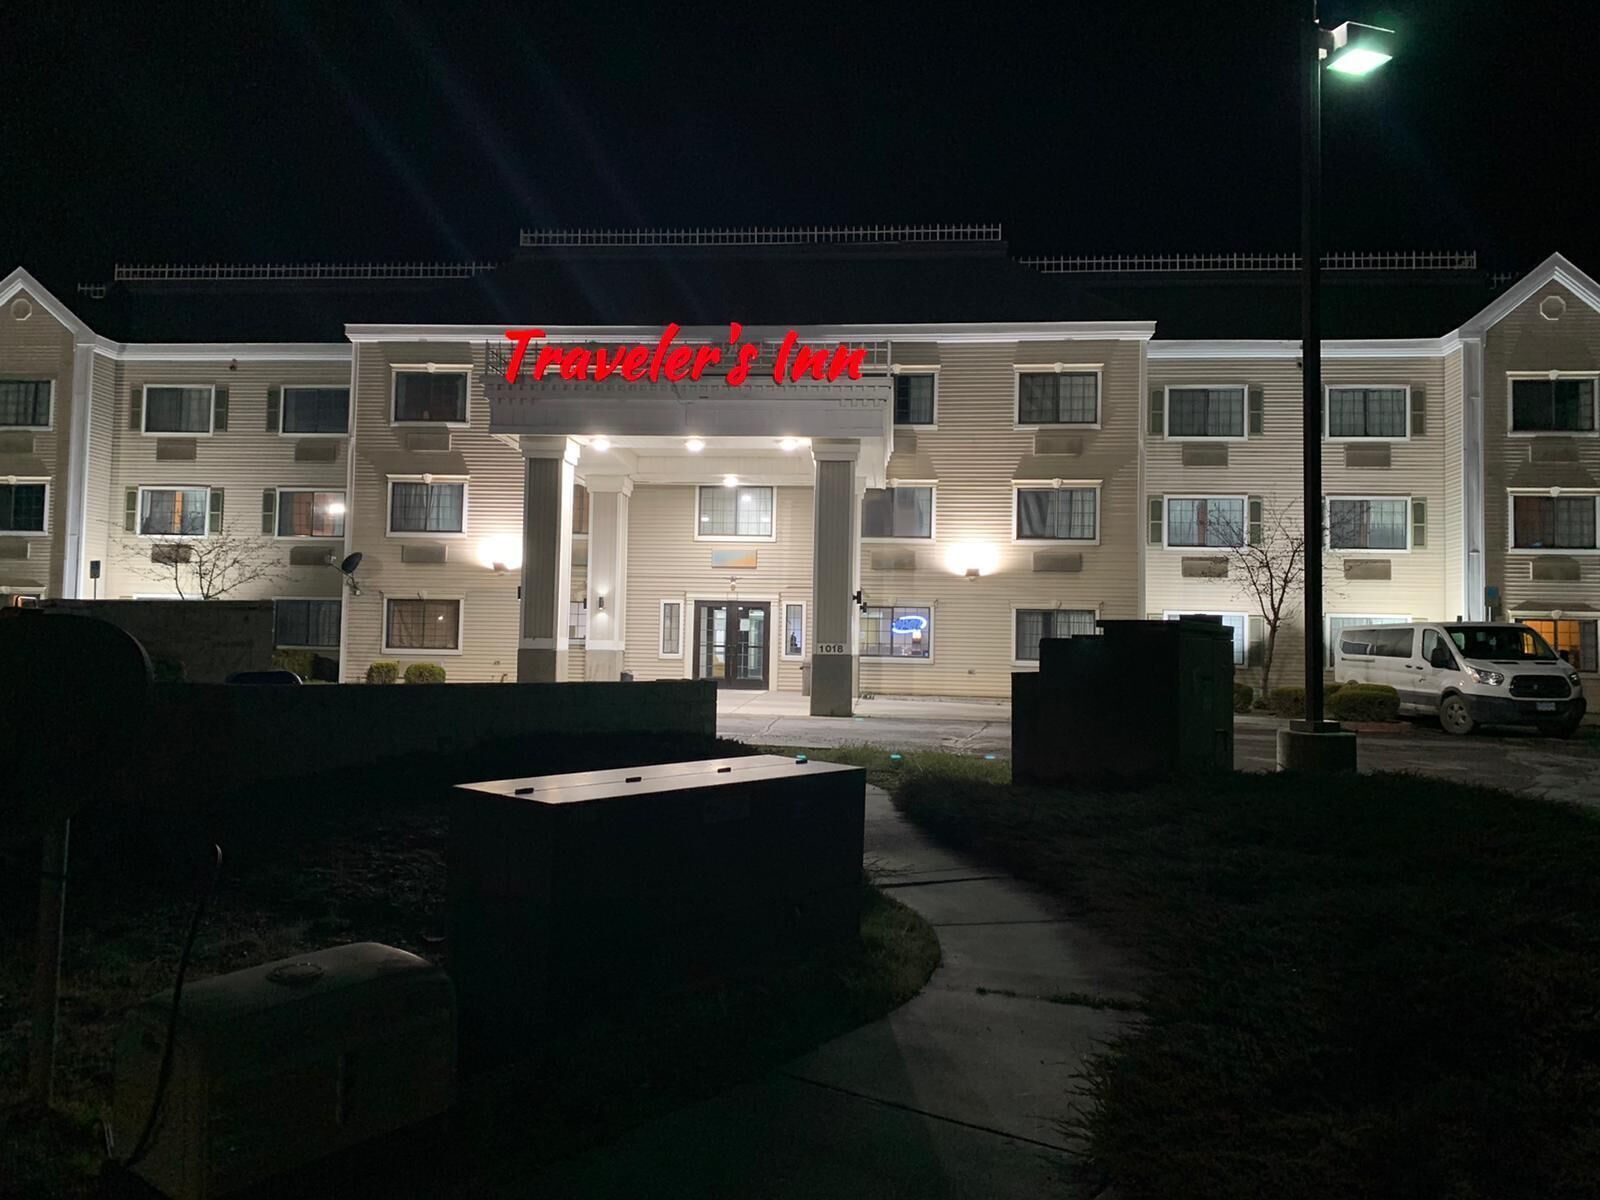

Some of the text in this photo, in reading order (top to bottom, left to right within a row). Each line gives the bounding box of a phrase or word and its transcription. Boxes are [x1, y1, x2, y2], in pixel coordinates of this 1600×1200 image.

[505, 322, 867, 386] Traveler's Inn
[819, 644, 844, 653] 1018
